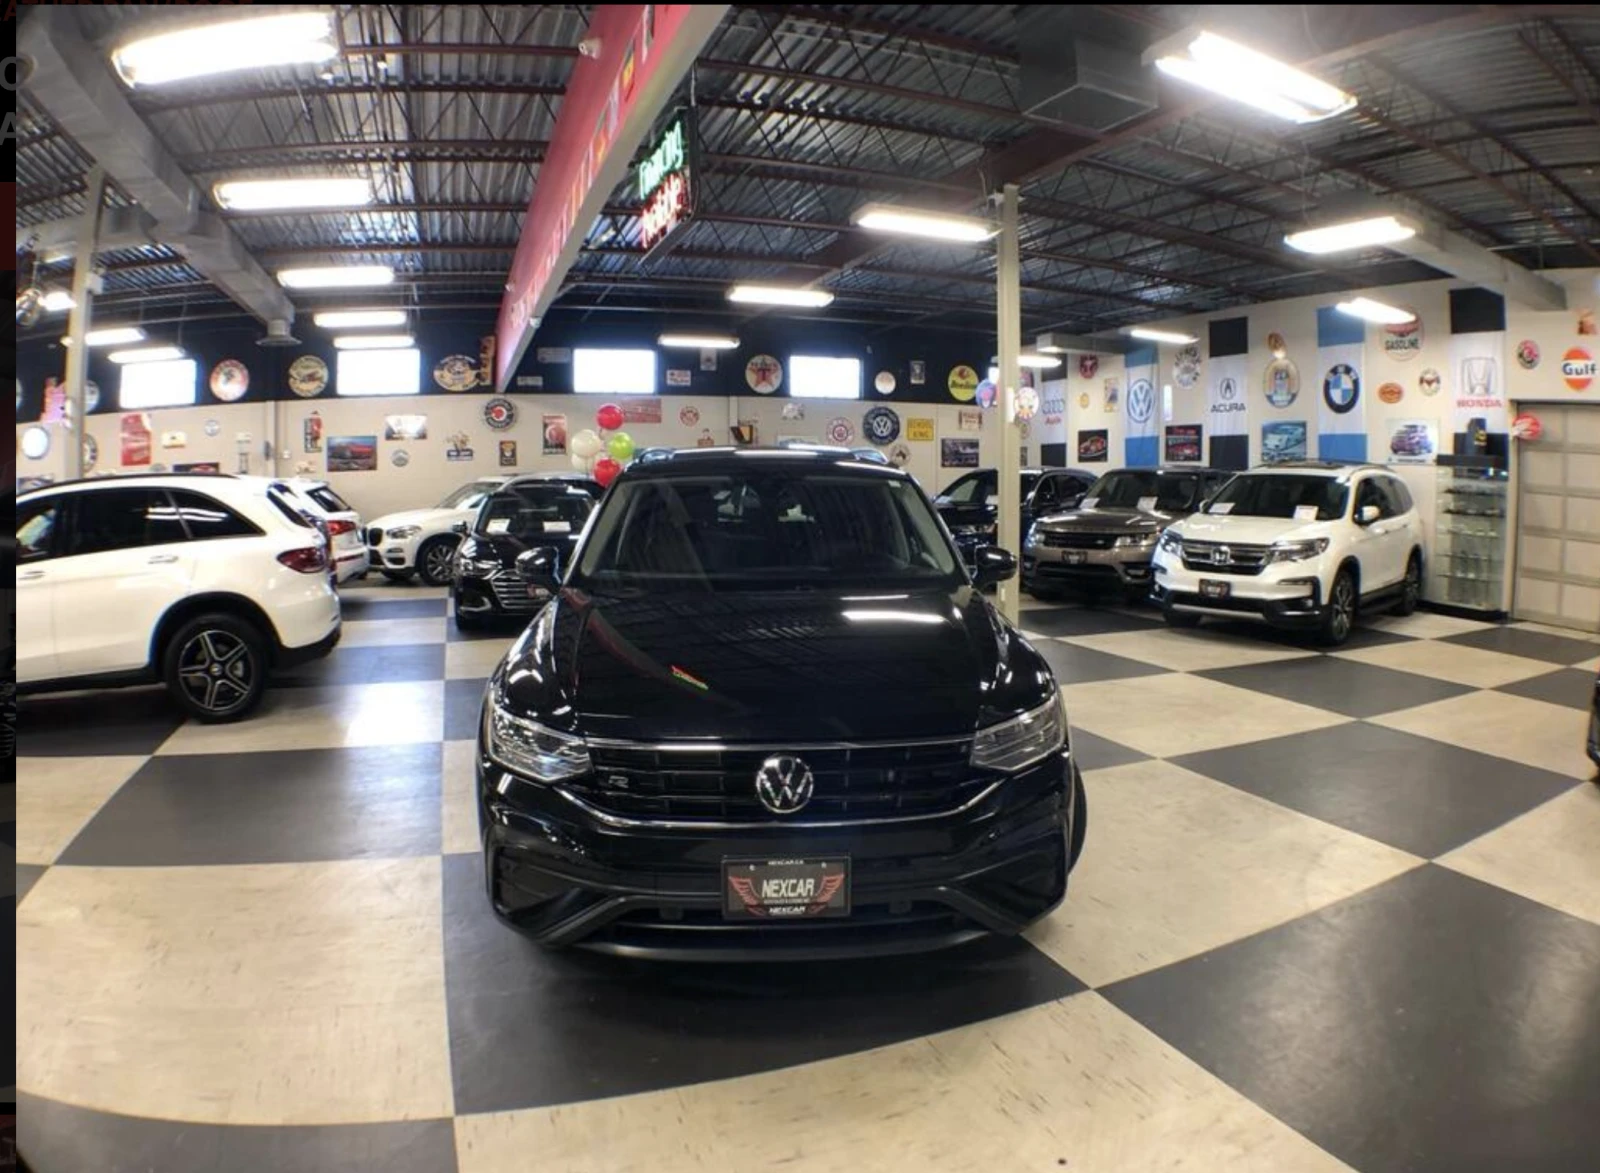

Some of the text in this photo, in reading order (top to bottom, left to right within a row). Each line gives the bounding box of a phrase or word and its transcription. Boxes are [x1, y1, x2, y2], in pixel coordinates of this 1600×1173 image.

[1385, 338, 1420, 351] GASOLINE
[1562, 362, 1598, 376] Gulf
[1210, 402, 1247, 413] ACURA
[1456, 398, 1502, 409] HONDA
[761, 877, 815, 898] NEXCAR
[769, 905, 806, 914] NEXCAR
